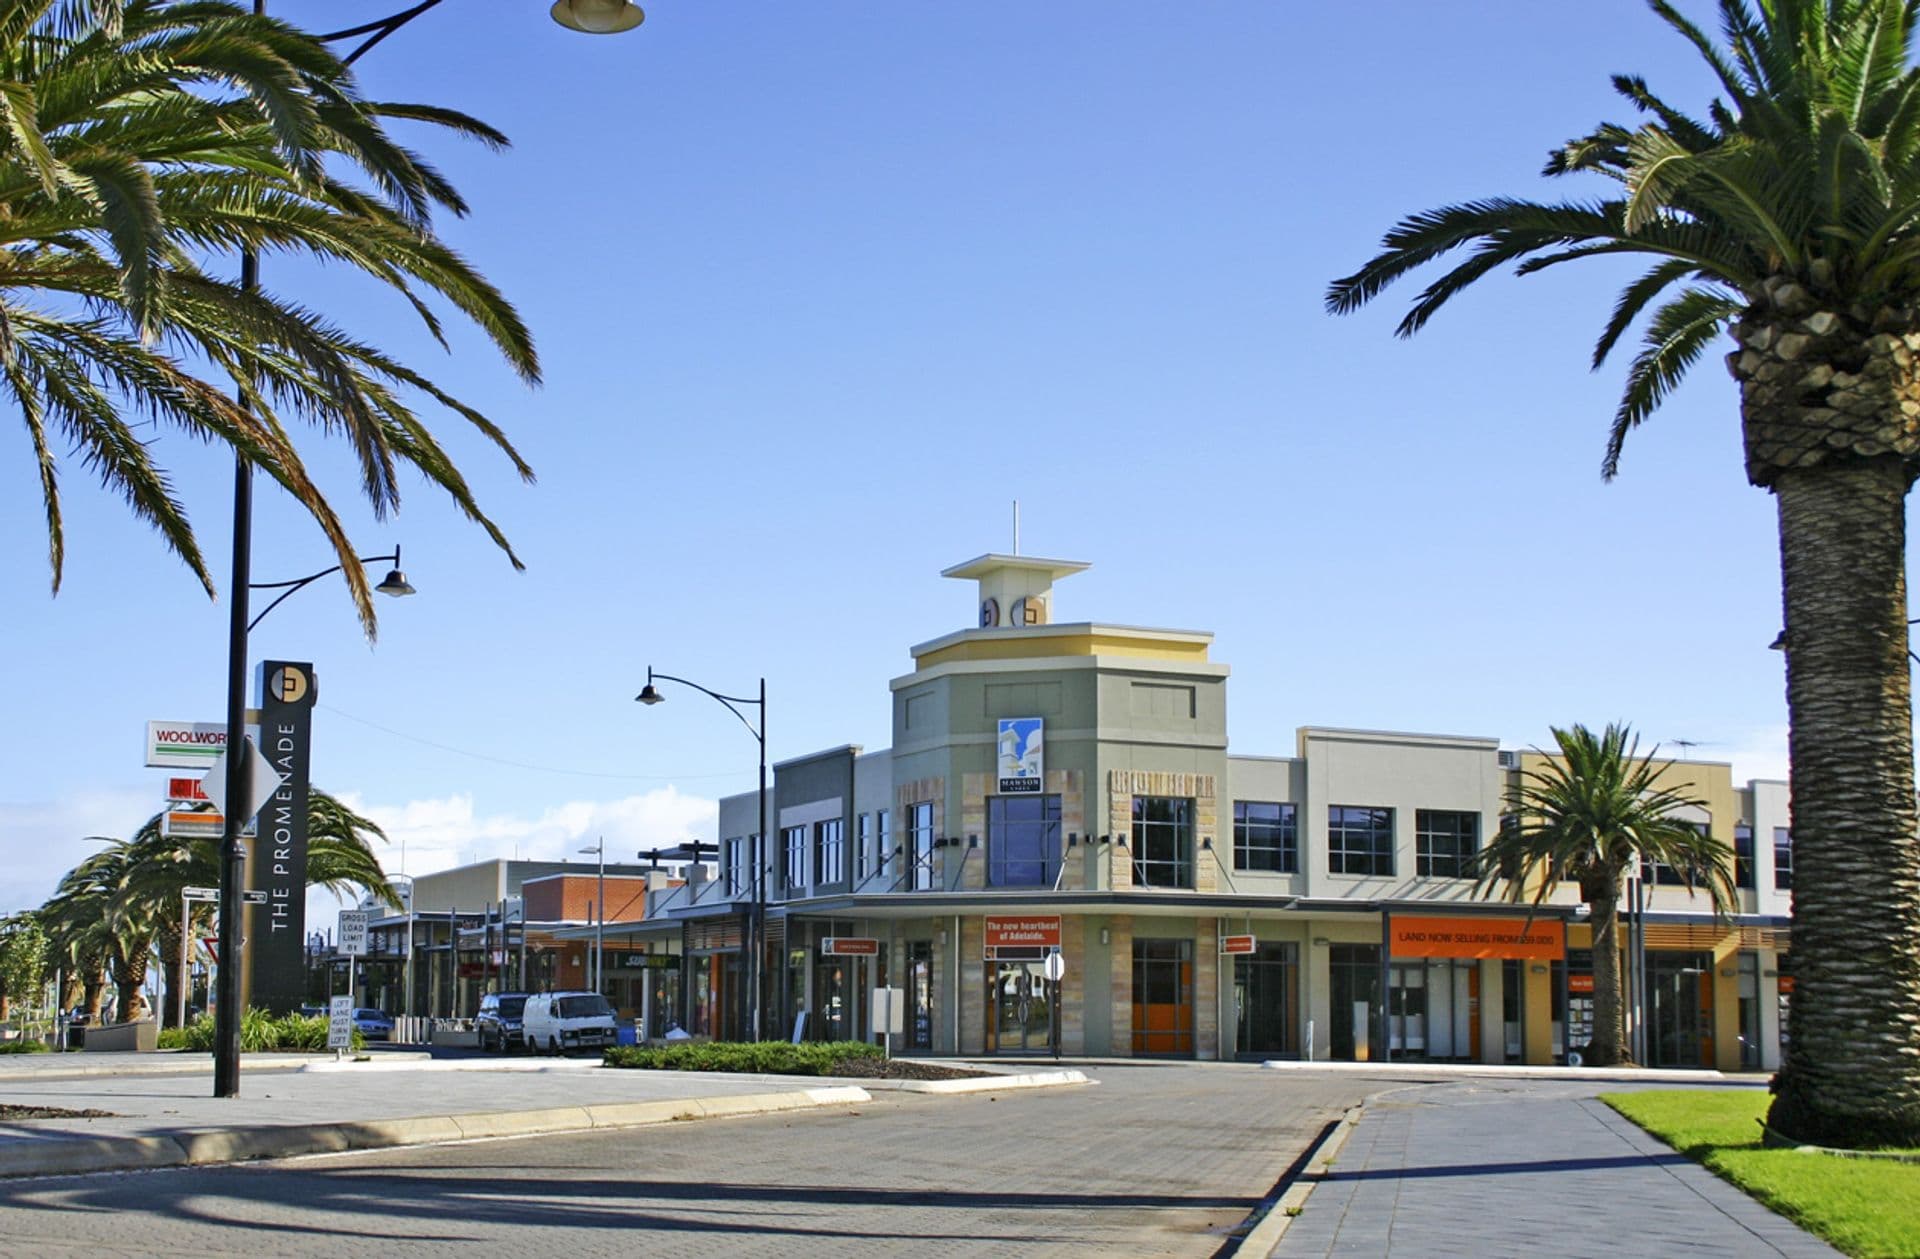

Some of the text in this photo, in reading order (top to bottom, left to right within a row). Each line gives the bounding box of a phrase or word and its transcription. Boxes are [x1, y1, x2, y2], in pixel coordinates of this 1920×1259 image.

[157, 730, 253, 745] WOOLWOR
[272, 724, 295, 933] THE PROMENADE
[342, 914, 366, 922] GROSS
[343, 924, 364, 932] LOAD
[987, 922, 1001, 930] The
[1021, 922, 1059, 930] heartbeat
[343, 934, 363, 942] LIMIT
[1000, 932, 1008, 940] of
[1399, 932, 1426, 942] LAND
[1429, 933, 1453, 943] NOW
[1455, 934, 1490, 944] SELLING
[1492, 935, 1520, 945] FROM
